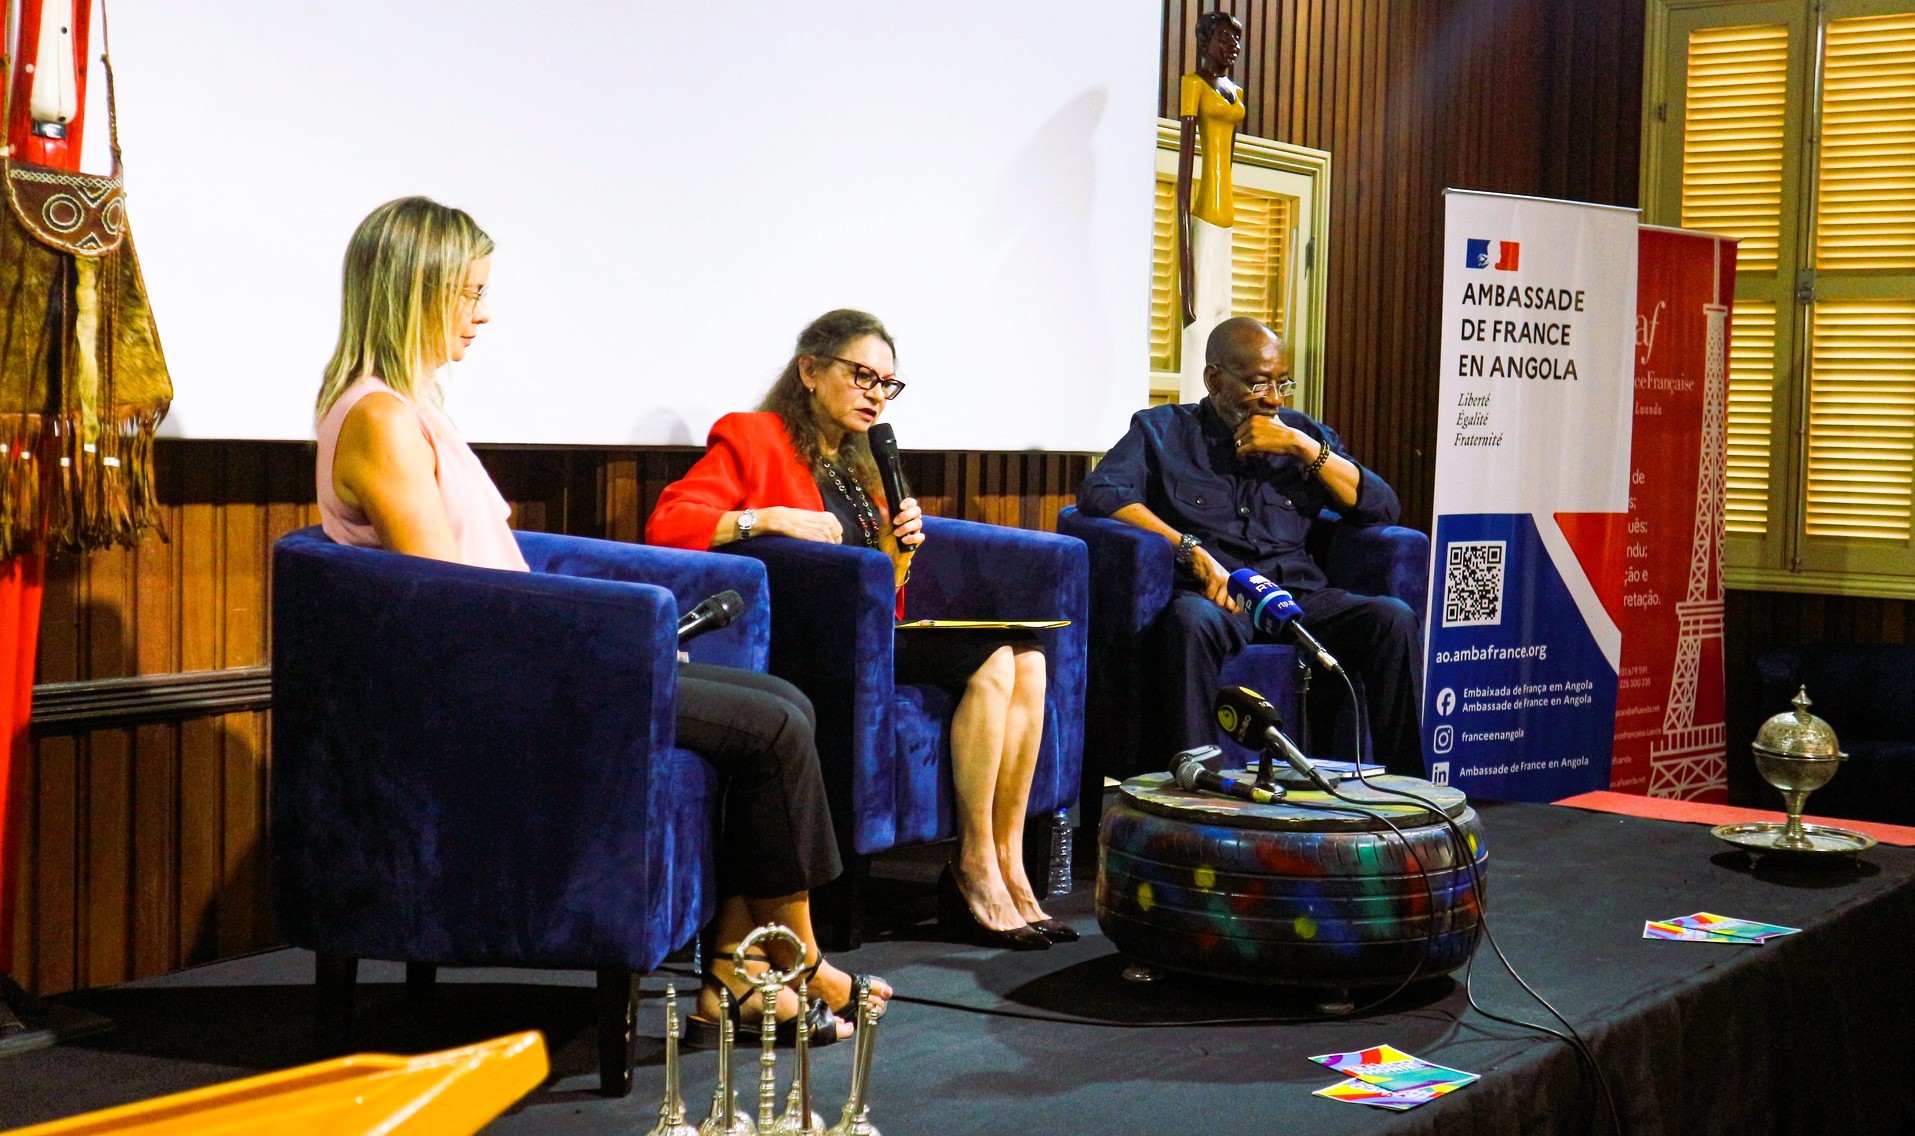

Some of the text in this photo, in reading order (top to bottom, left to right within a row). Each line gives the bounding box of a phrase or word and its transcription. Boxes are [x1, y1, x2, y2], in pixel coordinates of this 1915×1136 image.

[1462, 283, 1585, 312] AMBASSADE
[1461, 318, 1571, 346] DE FRANCE
[1459, 354, 1578, 381] EN ANGOLA
[1457, 392, 1491, 407] Liberté
[1456, 409, 1489, 430] Égalité
[1453, 432, 1503, 447] Fraternité
[1632, 468, 1645, 485] de
[1642, 570, 1649, 582] e
[1436, 644, 1547, 663] ao.ambafrance.org
[1463, 680, 1593, 699] Embaixada de França em Angola
[1462, 694, 1592, 713] Ambassade de France en Angola
[1461, 728, 1525, 742] franceenangola
[1459, 756, 1589, 778] Ambassade de France en Angola
